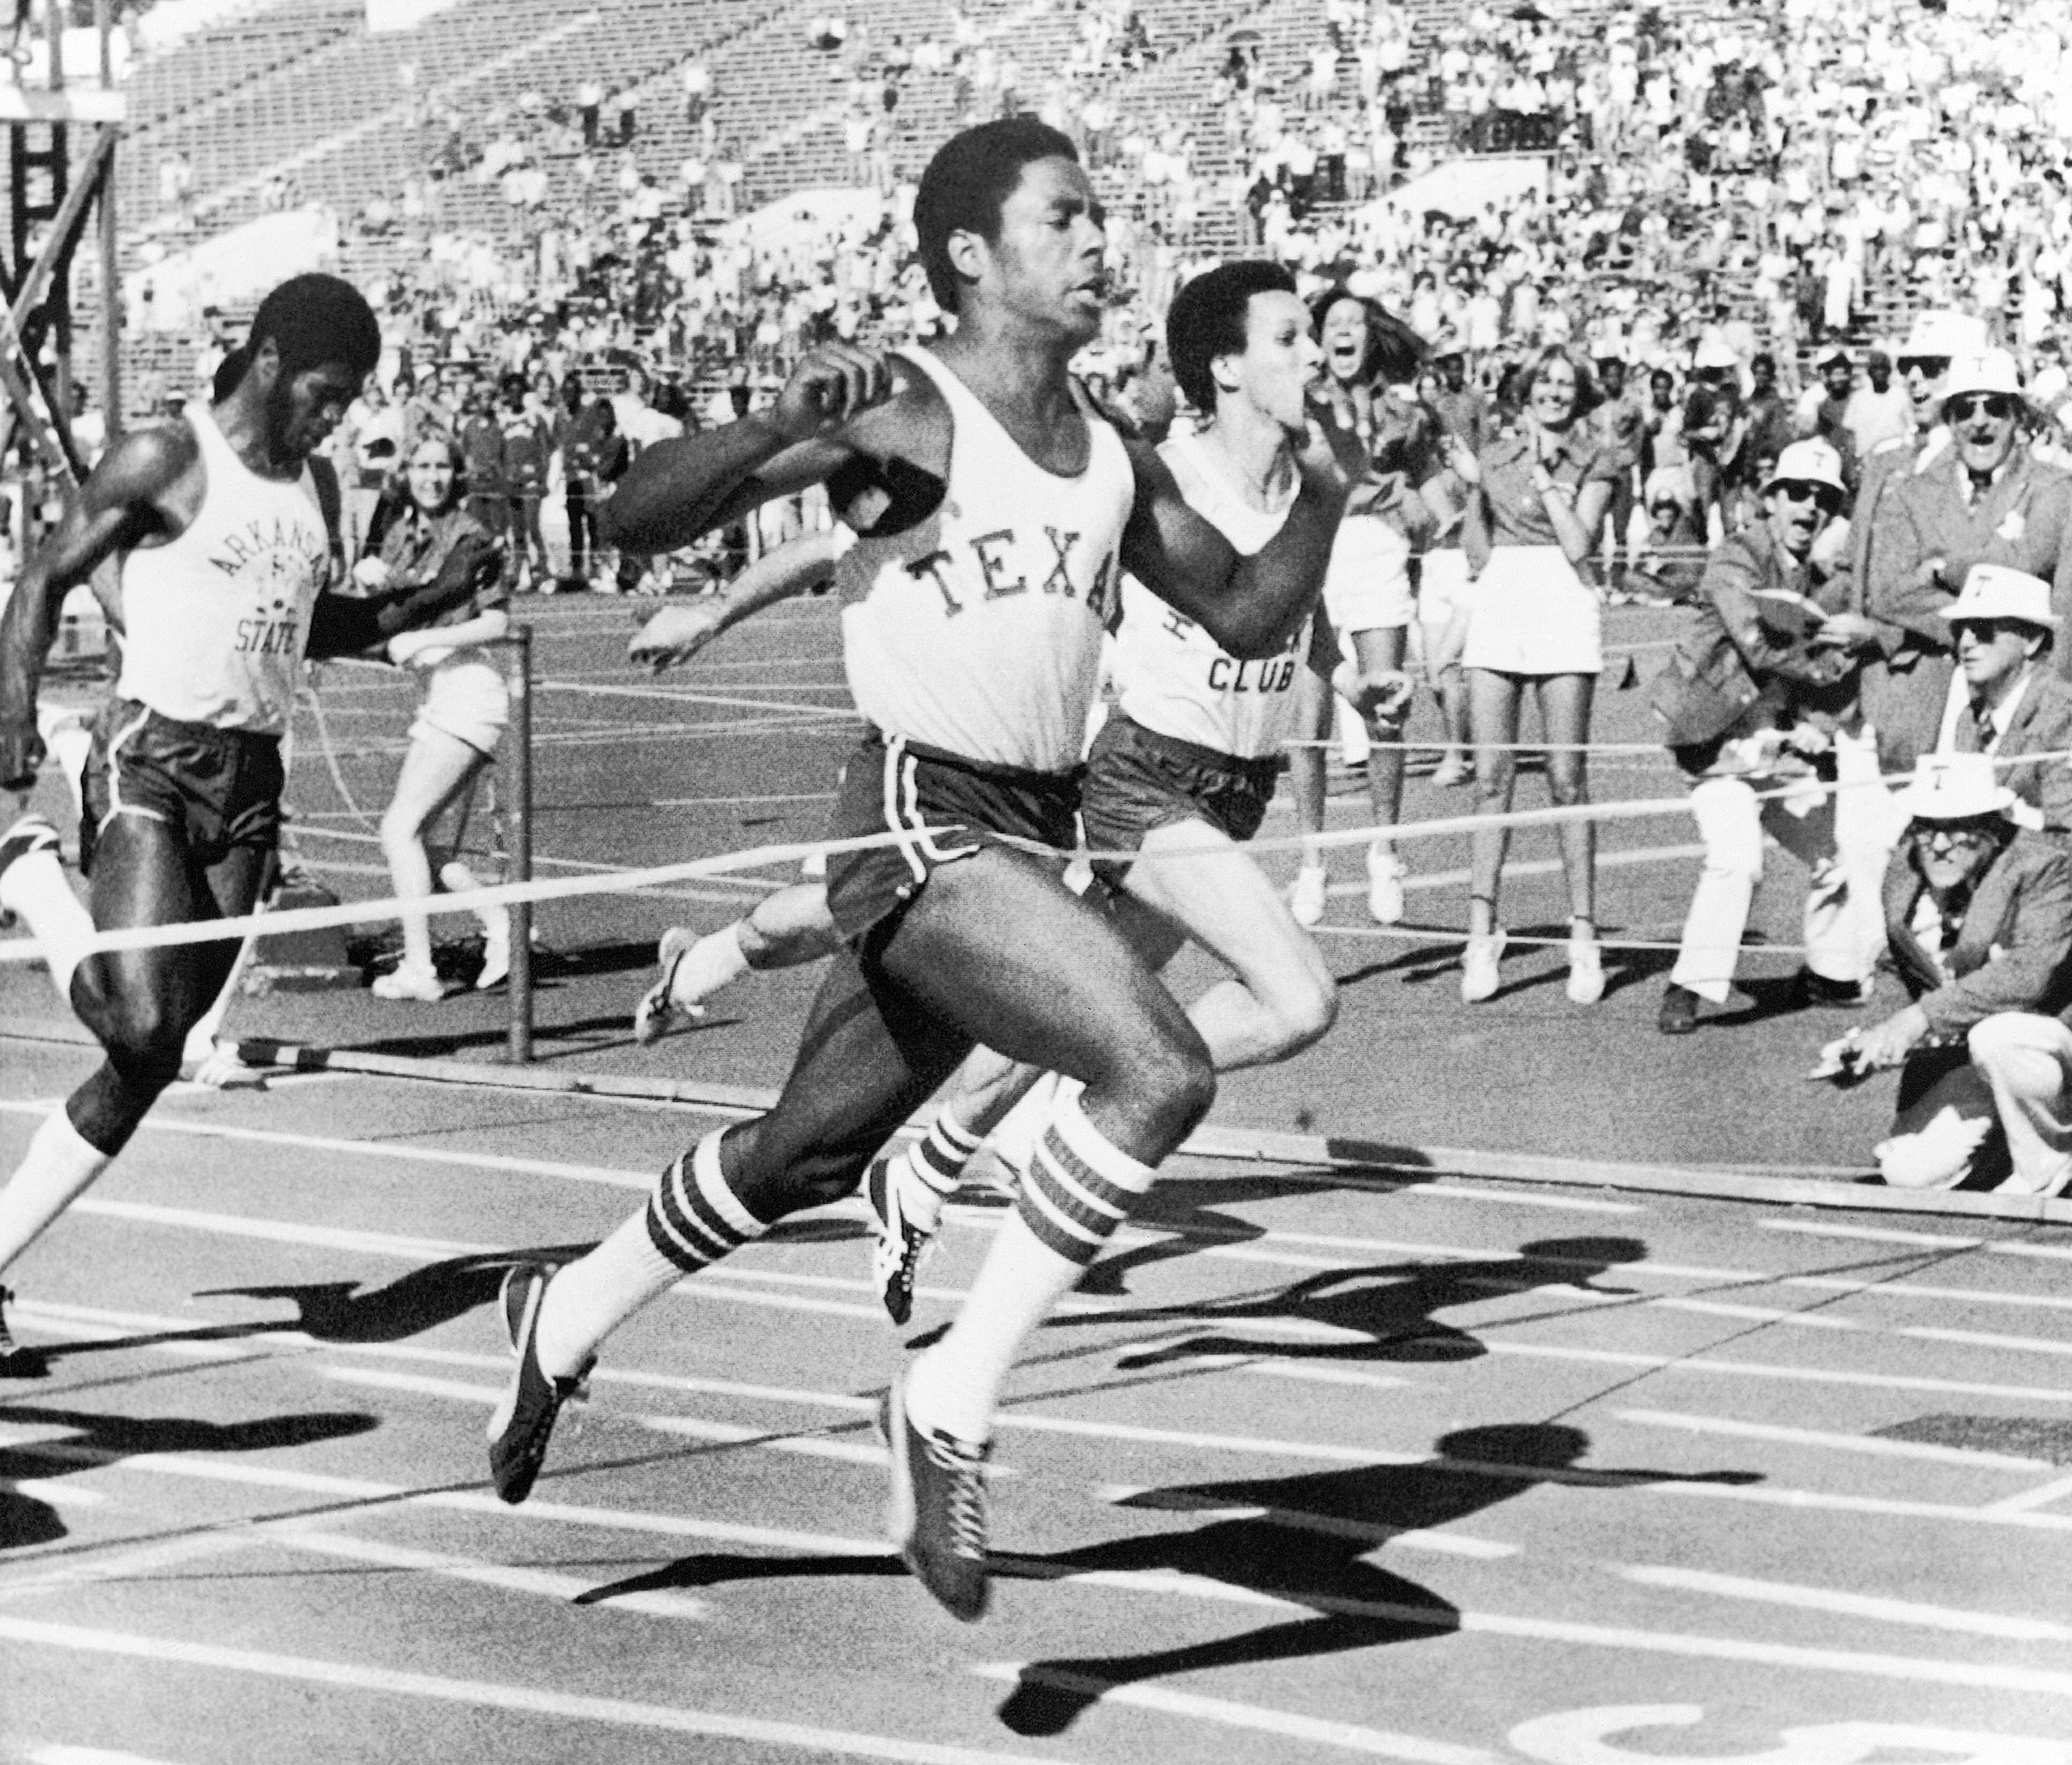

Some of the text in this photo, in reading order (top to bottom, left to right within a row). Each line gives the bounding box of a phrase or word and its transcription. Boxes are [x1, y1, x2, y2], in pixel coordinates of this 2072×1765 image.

[1973, 356, 1986, 372] T
[1814, 451, 1826, 468] T
[1975, 575, 1993, 598] T
[235, 619, 300, 655] STATE
[1208, 658, 1296, 693] CLUB
[1931, 765, 1950, 790] T
